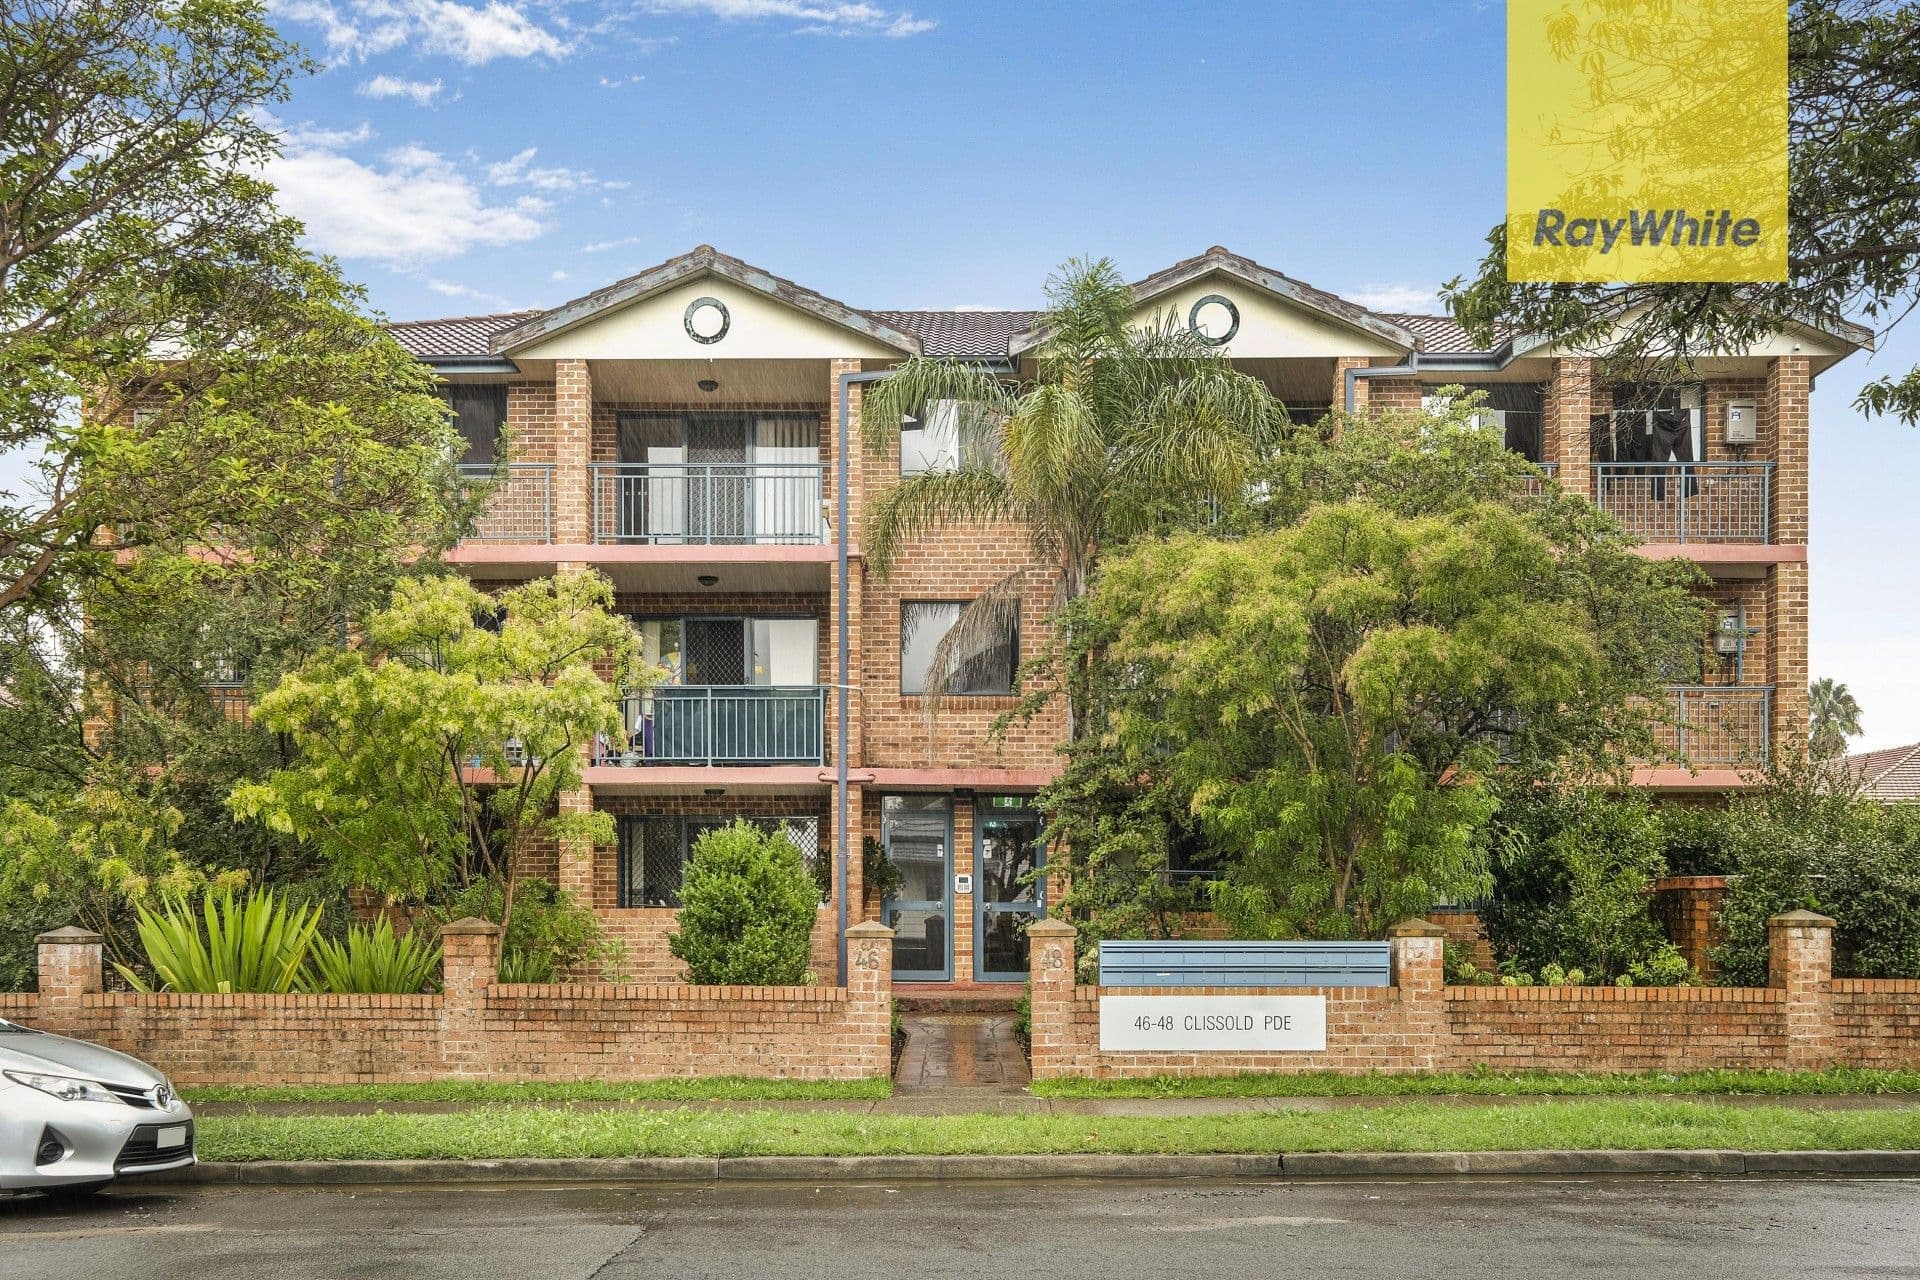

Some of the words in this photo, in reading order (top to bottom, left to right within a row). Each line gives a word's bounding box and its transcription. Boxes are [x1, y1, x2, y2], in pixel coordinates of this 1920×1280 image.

[855, 948, 880, 970] 46
[1040, 947, 1063, 969] 48
[1134, 1015, 1174, 1031] 46-48
[1184, 1015, 1253, 1031] CLISSOLD
[1264, 1015, 1292, 1031] PDE
